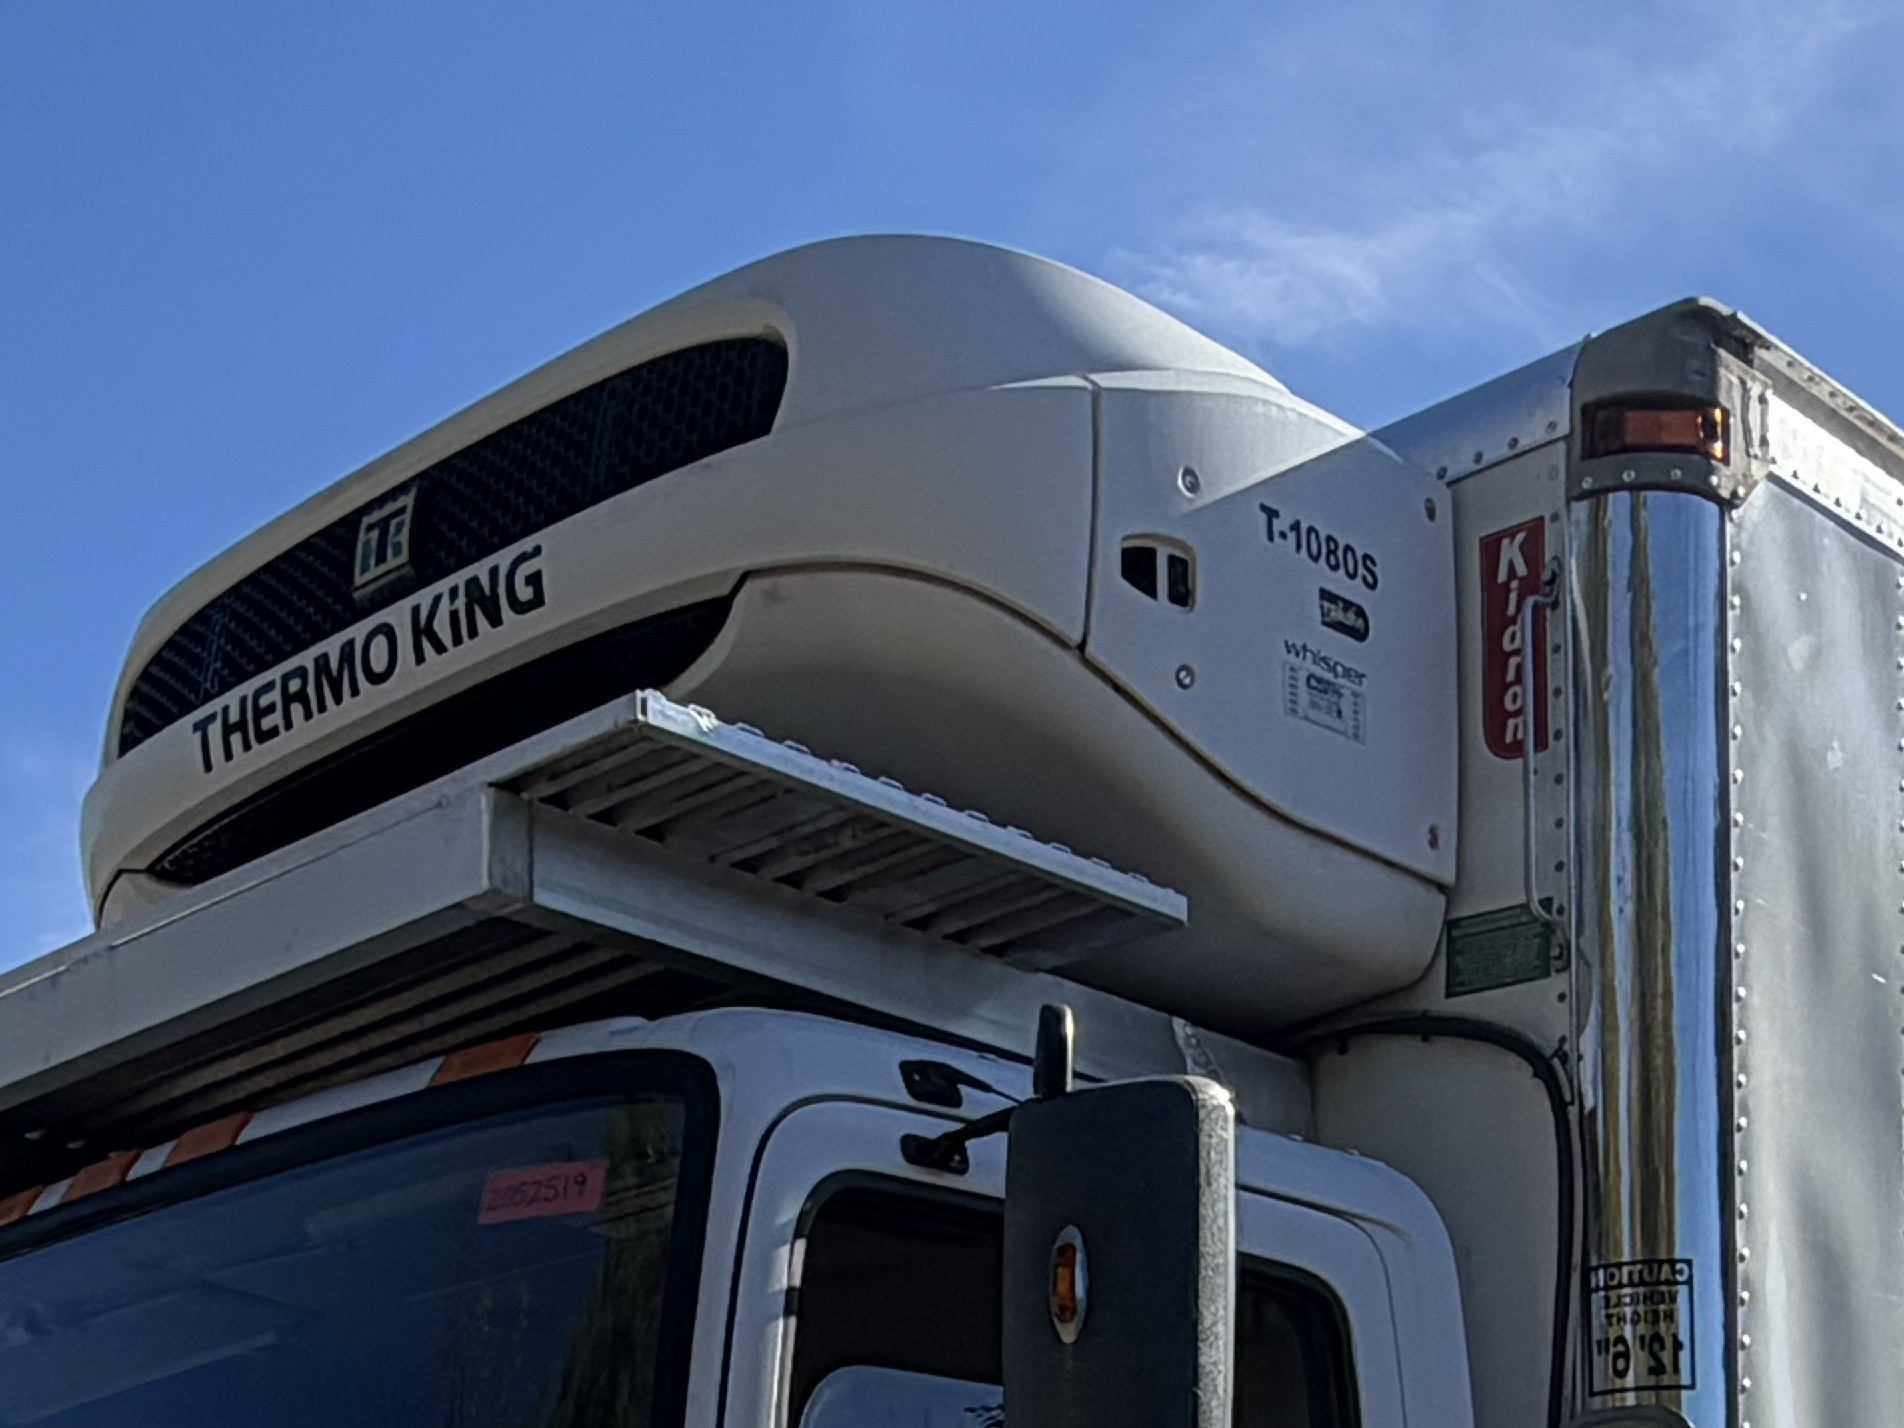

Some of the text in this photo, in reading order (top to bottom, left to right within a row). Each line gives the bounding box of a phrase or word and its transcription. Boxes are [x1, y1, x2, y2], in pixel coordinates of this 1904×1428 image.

[1259, 502, 1379, 591] T-1080S
[192, 622, 399, 774] THERMO
[1497, 531, 1526, 744] Kidron
